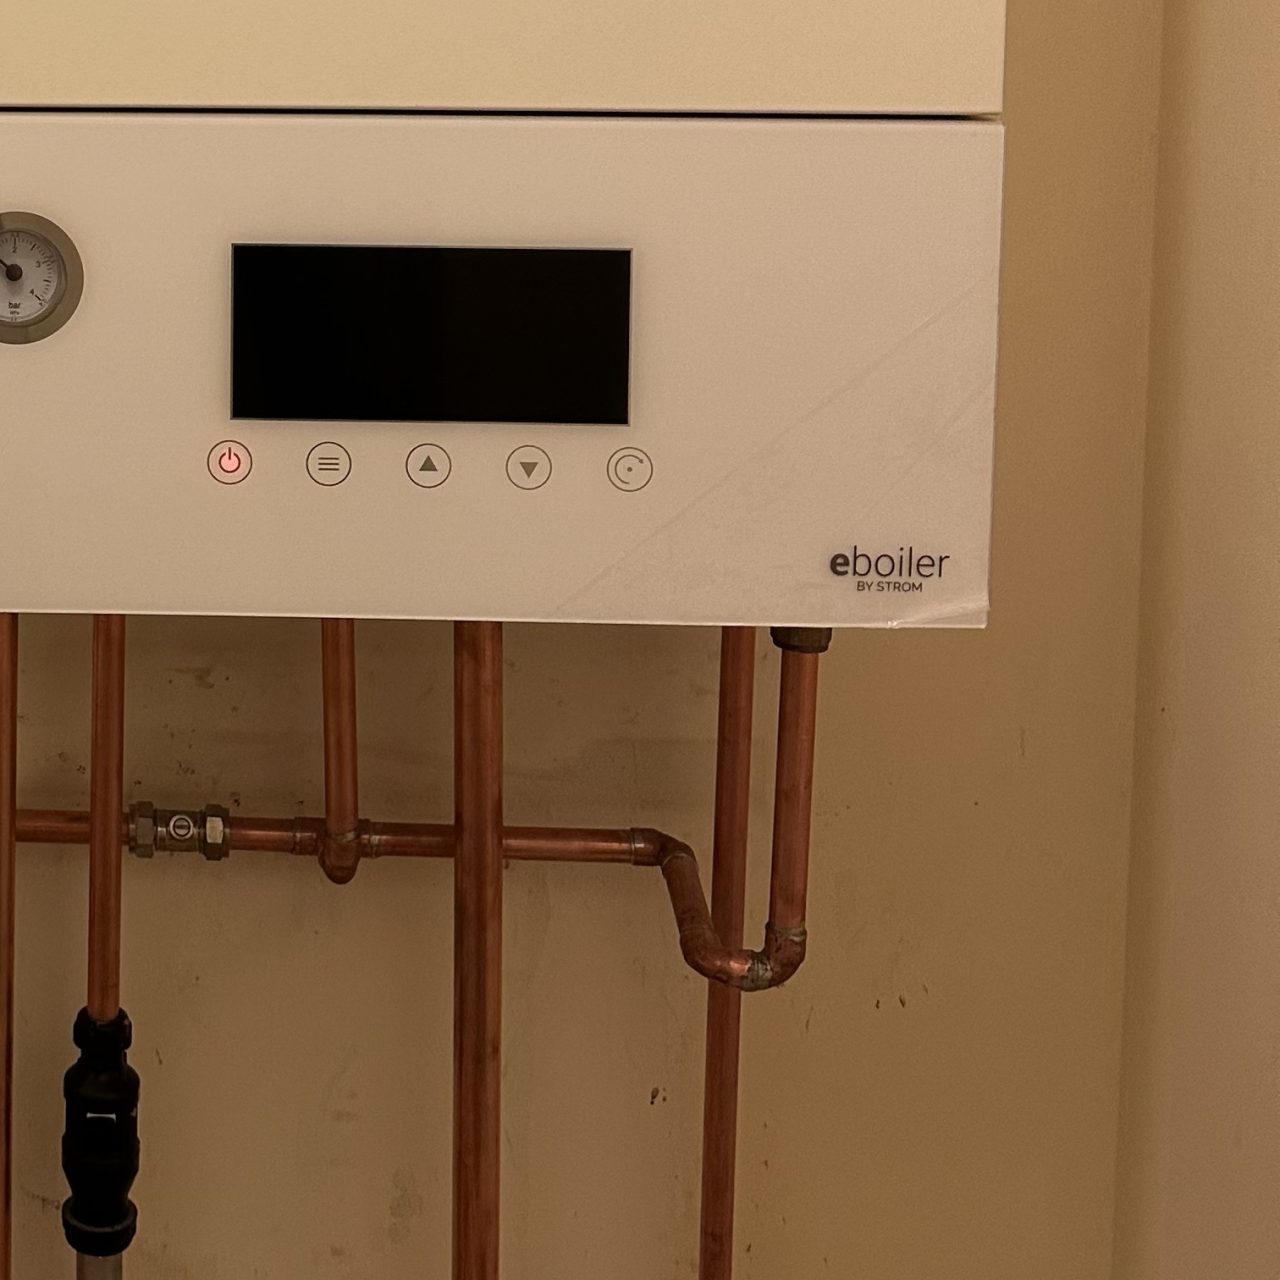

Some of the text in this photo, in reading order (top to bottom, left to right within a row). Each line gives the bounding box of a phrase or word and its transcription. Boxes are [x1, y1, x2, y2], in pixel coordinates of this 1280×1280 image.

[830, 545, 951, 578] eboiler
[856, 581, 923, 592] BY STROM
